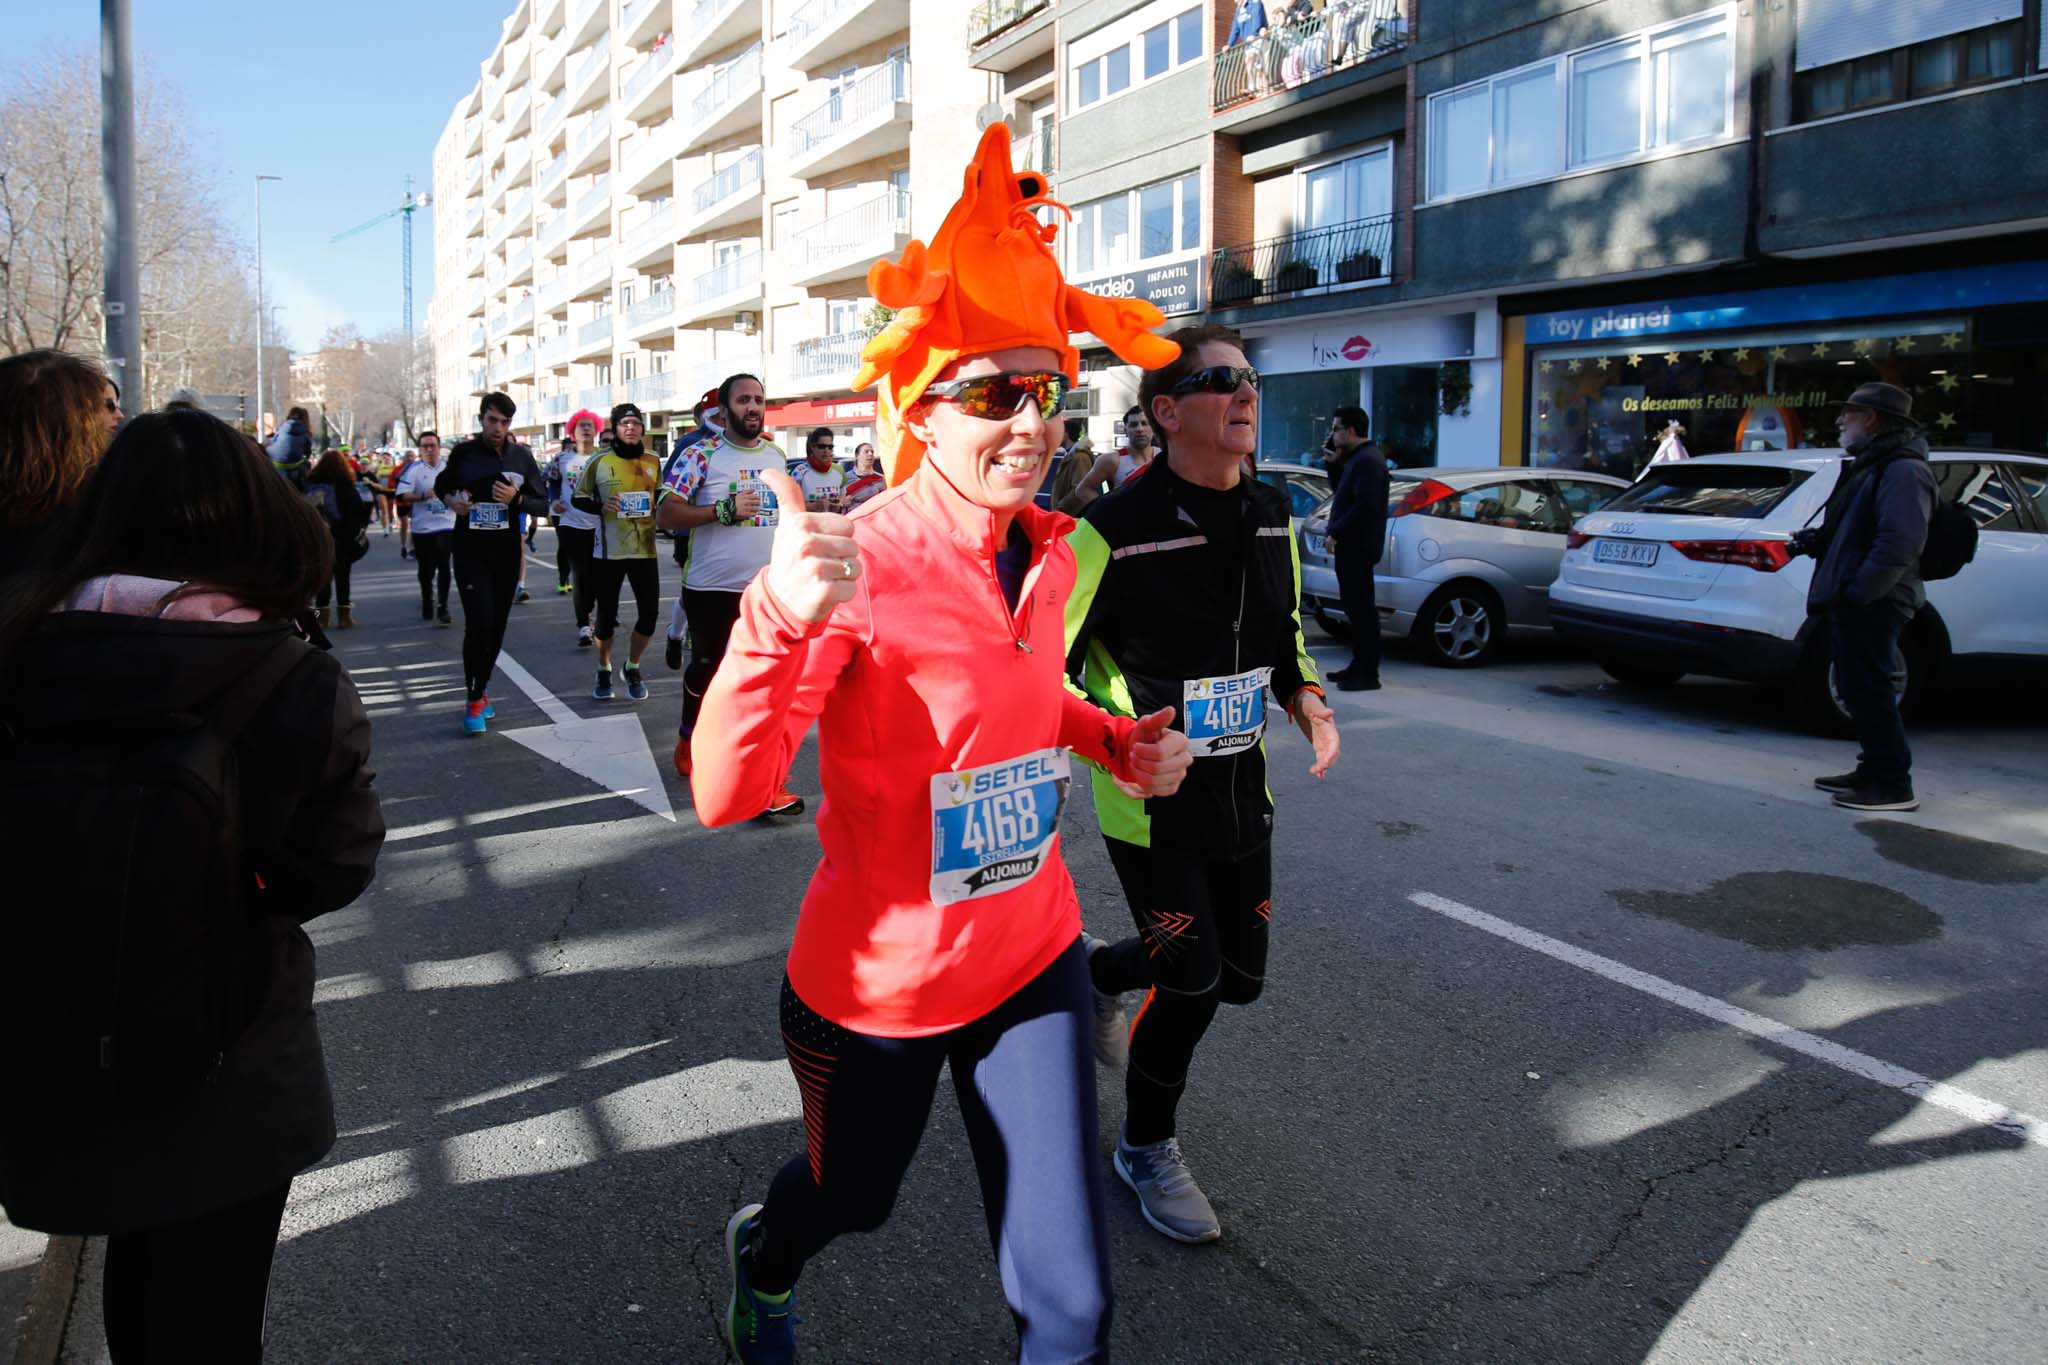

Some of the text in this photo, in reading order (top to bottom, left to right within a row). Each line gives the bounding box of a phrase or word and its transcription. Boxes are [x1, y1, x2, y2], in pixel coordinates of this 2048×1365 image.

[1147, 266, 1188, 283] INFANTIL
[1149, 285, 1186, 300] ADULTO
[1548, 305, 1671, 340] toy planet
[1622, 397, 1638, 412] Os
[1641, 395, 1703, 411] deseamos
[1706, 393, 1738, 409] Feliz
[1741, 391, 1804, 409] Navidad
[623, 498, 642, 511] 3517
[1601, 542, 1628, 560] 0558
[1212, 670, 1263, 695] SETEL
[1203, 691, 1254, 730] 4167
[1217, 735, 1252, 748] ALJOMAR
[974, 757, 1055, 794] SETEL
[961, 787, 1039, 856] 4168
[979, 843, 1025, 866] ESTRELLA
[981, 860, 1034, 884] ALJOMAR
